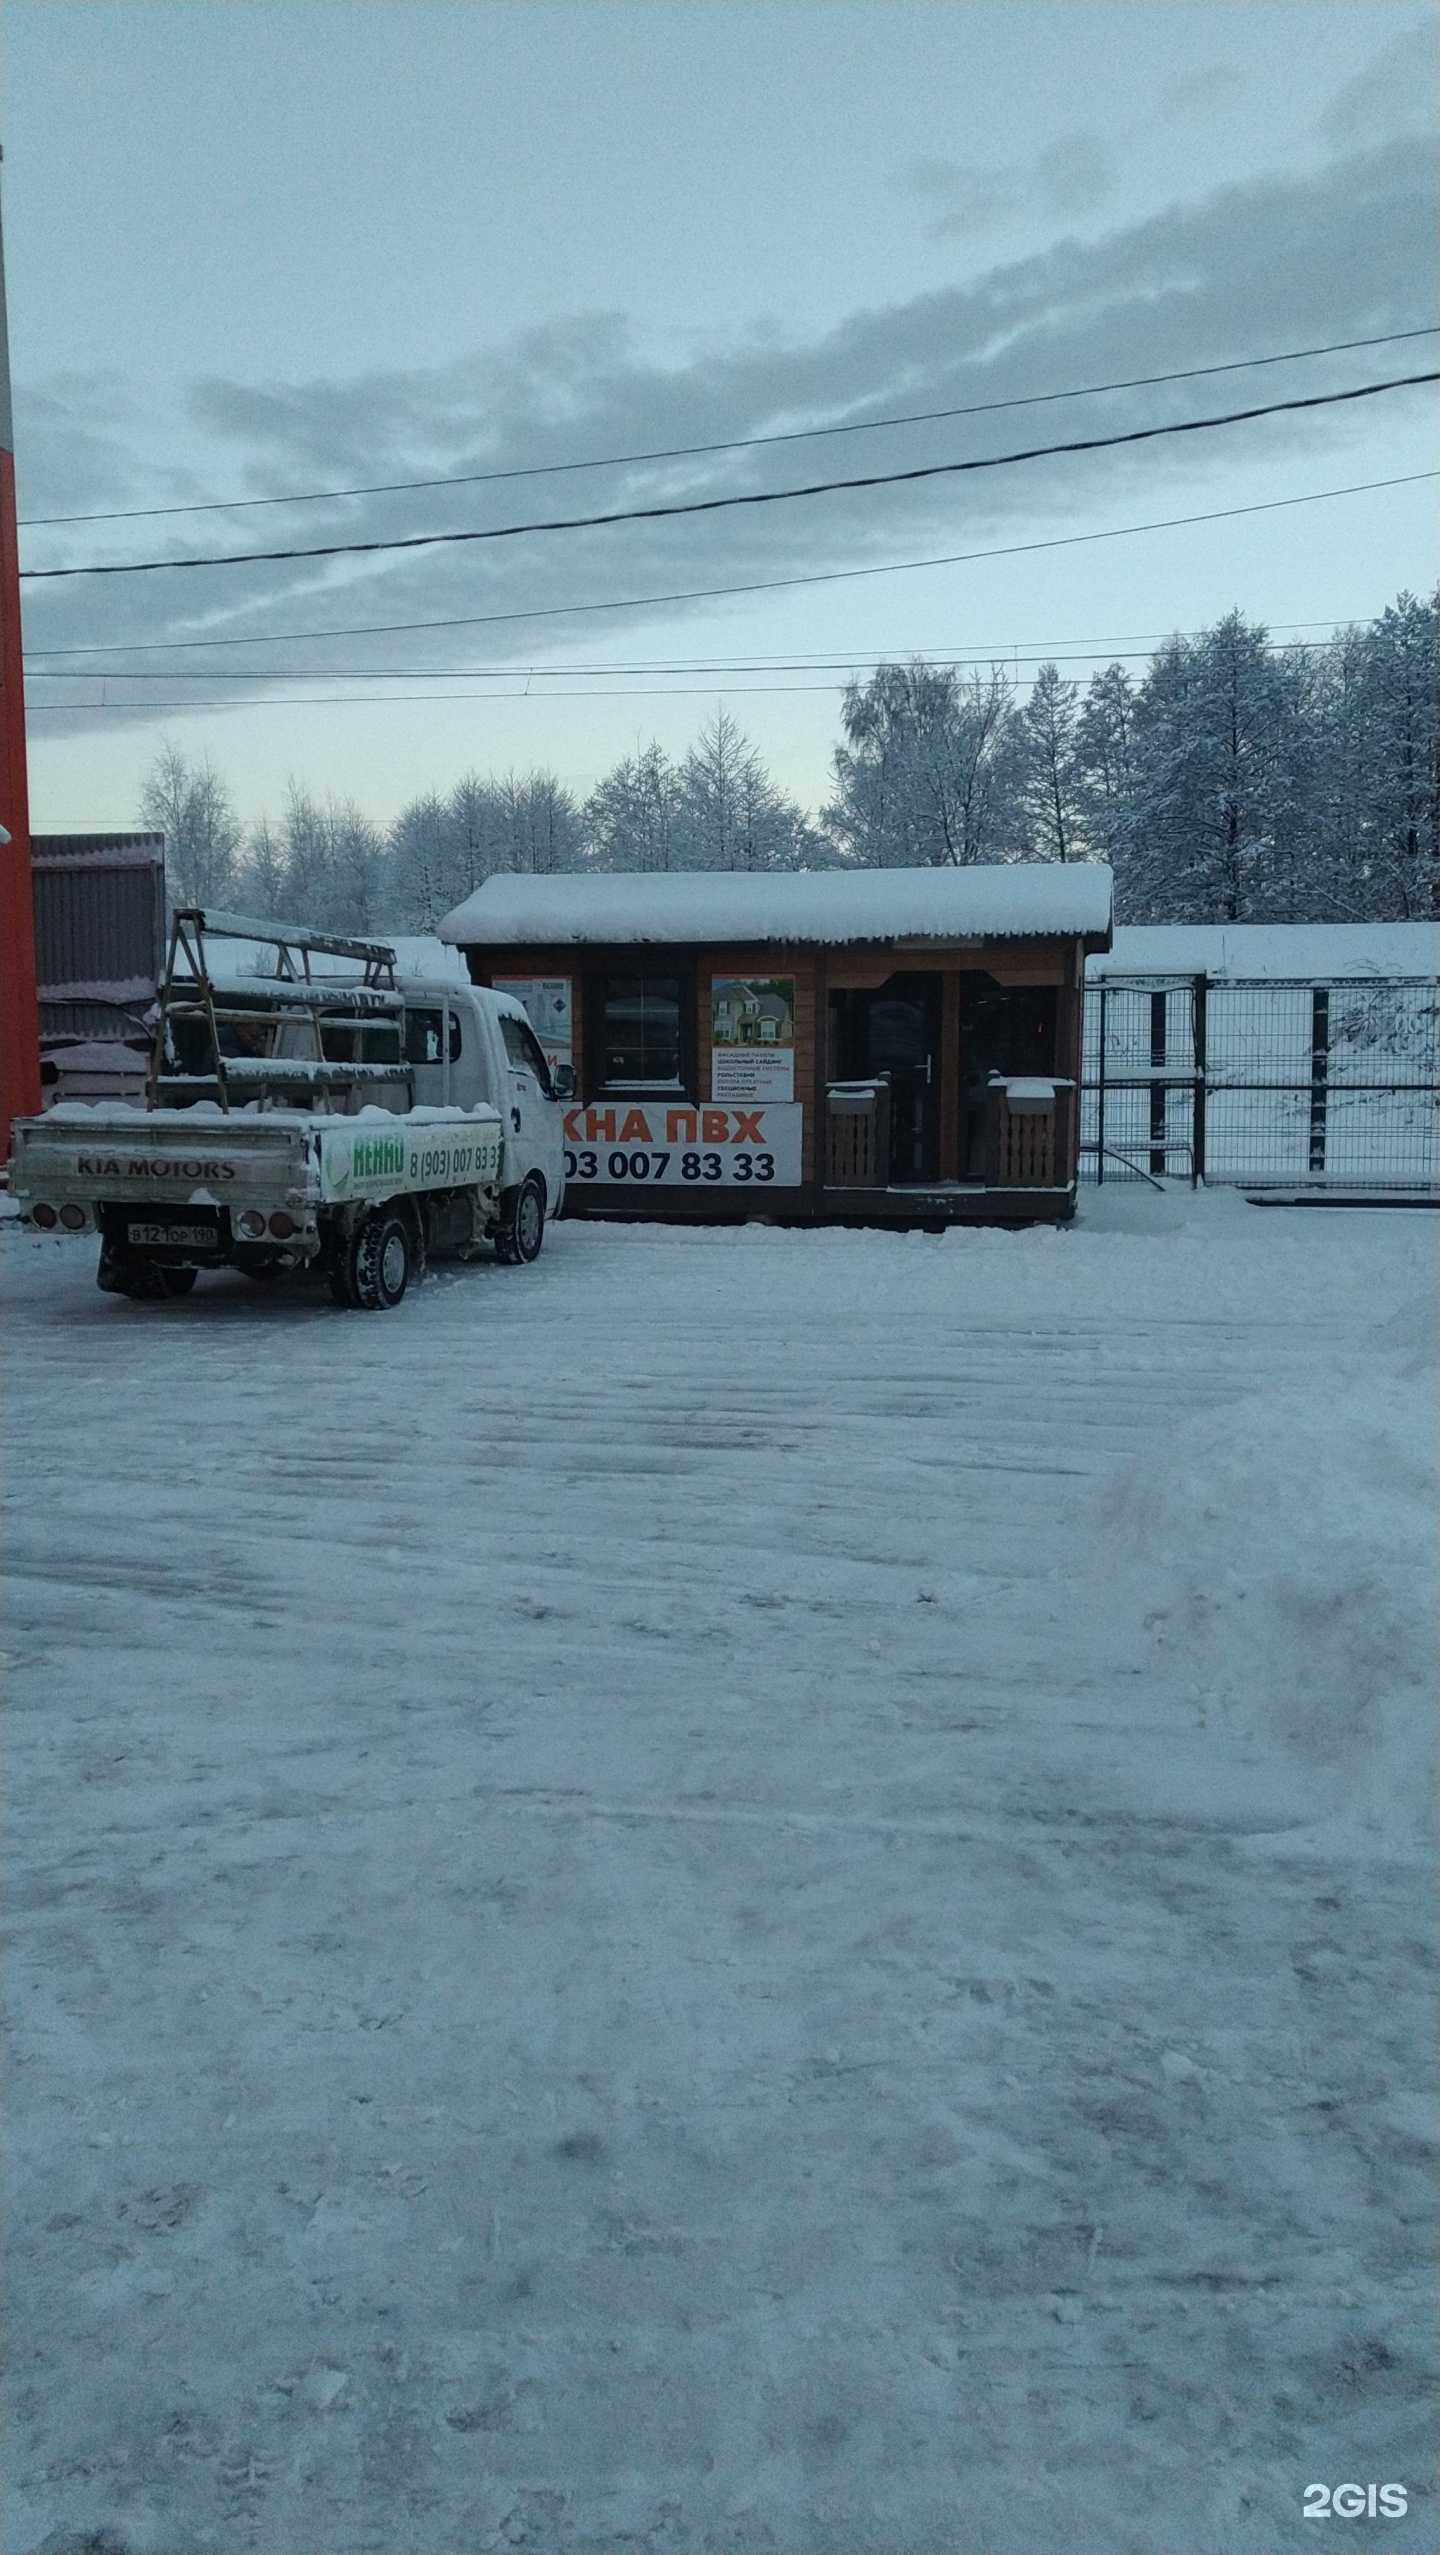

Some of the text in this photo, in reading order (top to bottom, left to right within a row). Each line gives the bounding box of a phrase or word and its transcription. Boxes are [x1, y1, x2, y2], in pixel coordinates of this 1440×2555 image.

[666, 1109, 767, 1144] ПВХ
[78, 1157, 235, 1179] KIA MOTORS
[410, 1153, 418, 1178] 8
[421, 1150, 450, 1183] (903)
[453, 1147, 473, 1173] 007
[476, 1146, 487, 1170] 83
[608, 1152, 671, 1179] 007
[681, 1152, 722, 1180] 83
[733, 1153, 775, 1181] 33
